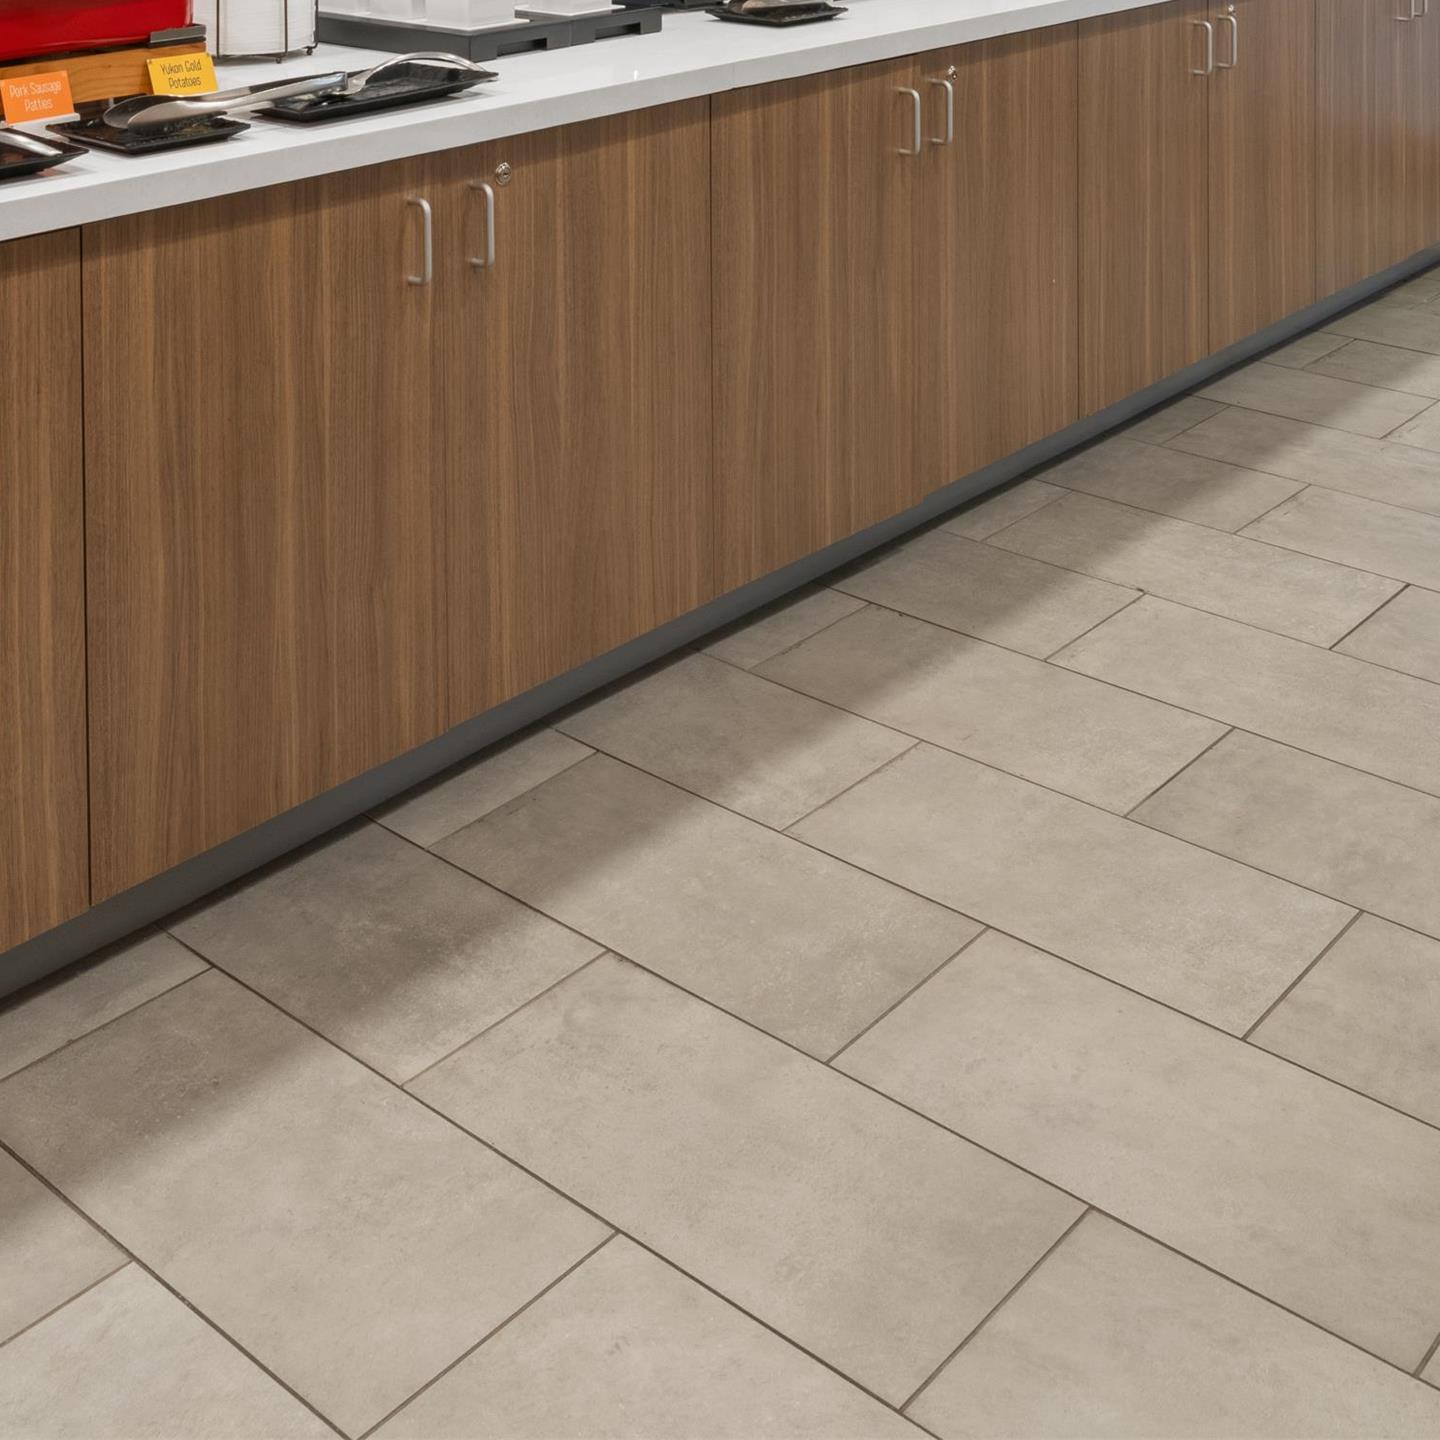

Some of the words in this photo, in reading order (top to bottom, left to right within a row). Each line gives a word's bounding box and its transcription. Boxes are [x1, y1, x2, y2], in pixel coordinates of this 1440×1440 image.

[160, 62, 184, 75] Yukon
[184, 59, 202, 72] Gold
[168, 76, 202, 89] Potatoes
[24, 98, 54, 113] Patties
